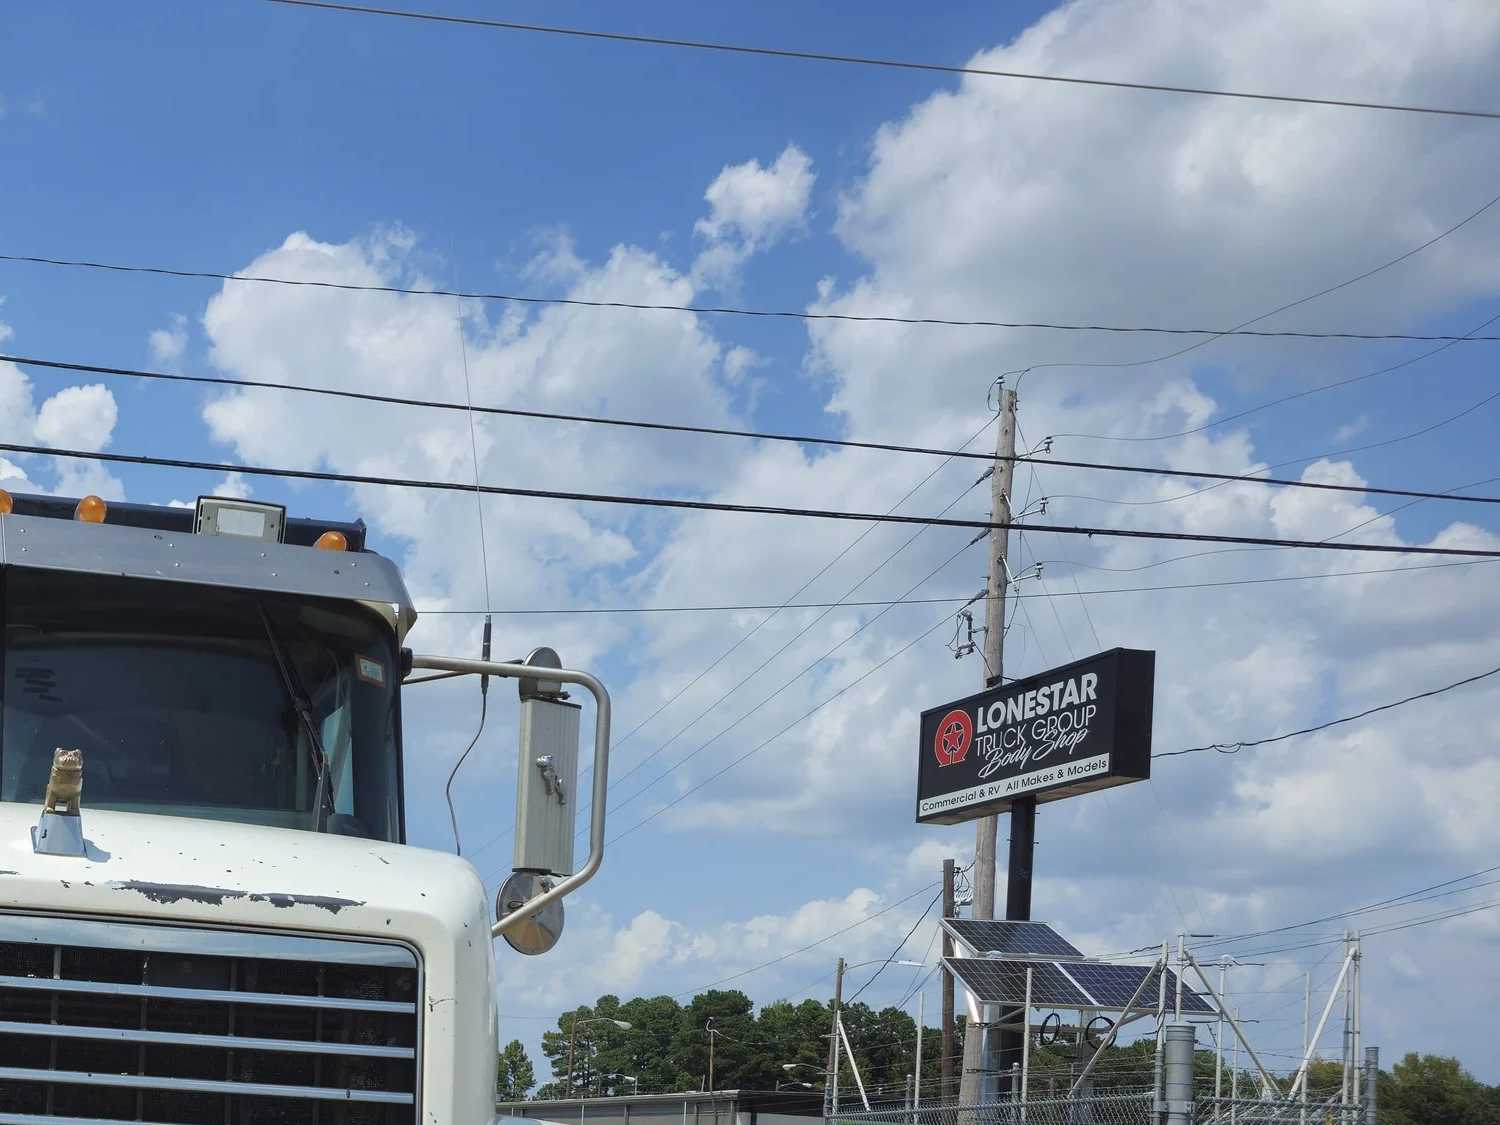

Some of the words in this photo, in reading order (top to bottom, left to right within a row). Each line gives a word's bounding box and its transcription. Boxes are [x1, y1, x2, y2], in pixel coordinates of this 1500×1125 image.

[976, 672, 1098, 733] LONESTAR
[975, 723, 1027, 756] TRUCK
[1031, 704, 1097, 740] GROUP
[978, 741, 1032, 778] Body
[1032, 728, 1089, 761] Shop
[922, 791, 976, 811] Commercial
[979, 789, 985, 798] &
[988, 785, 1000, 796] RV
[1006, 781, 1019, 791] All
[1021, 773, 1054, 787] Makes
[1057, 769, 1064, 779] &
[1067, 759, 1107, 776] Models
